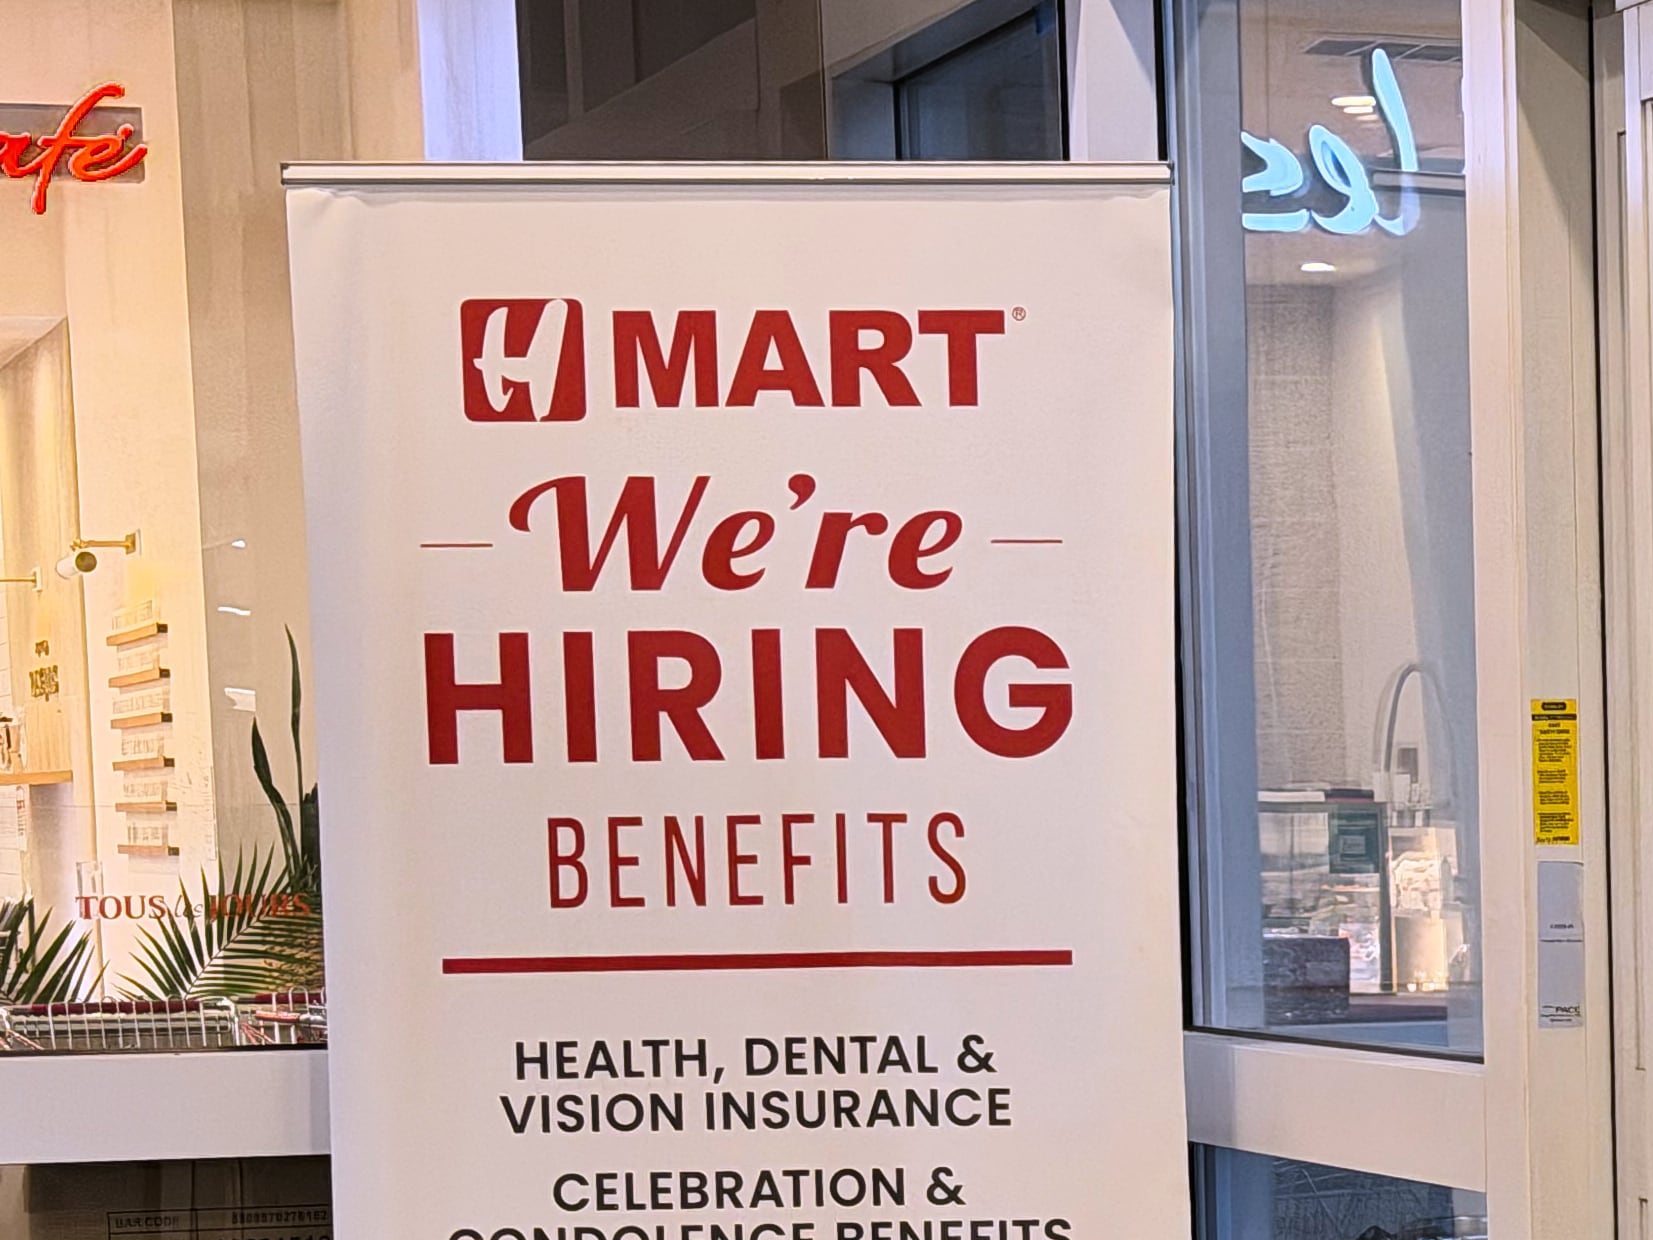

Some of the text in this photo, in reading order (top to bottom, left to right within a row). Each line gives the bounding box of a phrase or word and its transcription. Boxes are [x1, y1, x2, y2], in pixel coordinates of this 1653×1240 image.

[612, 310, 1006, 408] MART
[508, 473, 963, 592] We’re
[423, 625, 1073, 765] HIRING
[547, 812, 966, 909] BENEFITS
[75, 892, 311, 921] TOUS les JOURS
[515, 1034, 997, 1085] HEALTH, DENTAL &
[499, 1087, 1012, 1134] VISION INSURANCE
[552, 1166, 966, 1212] CELEBRATION &
